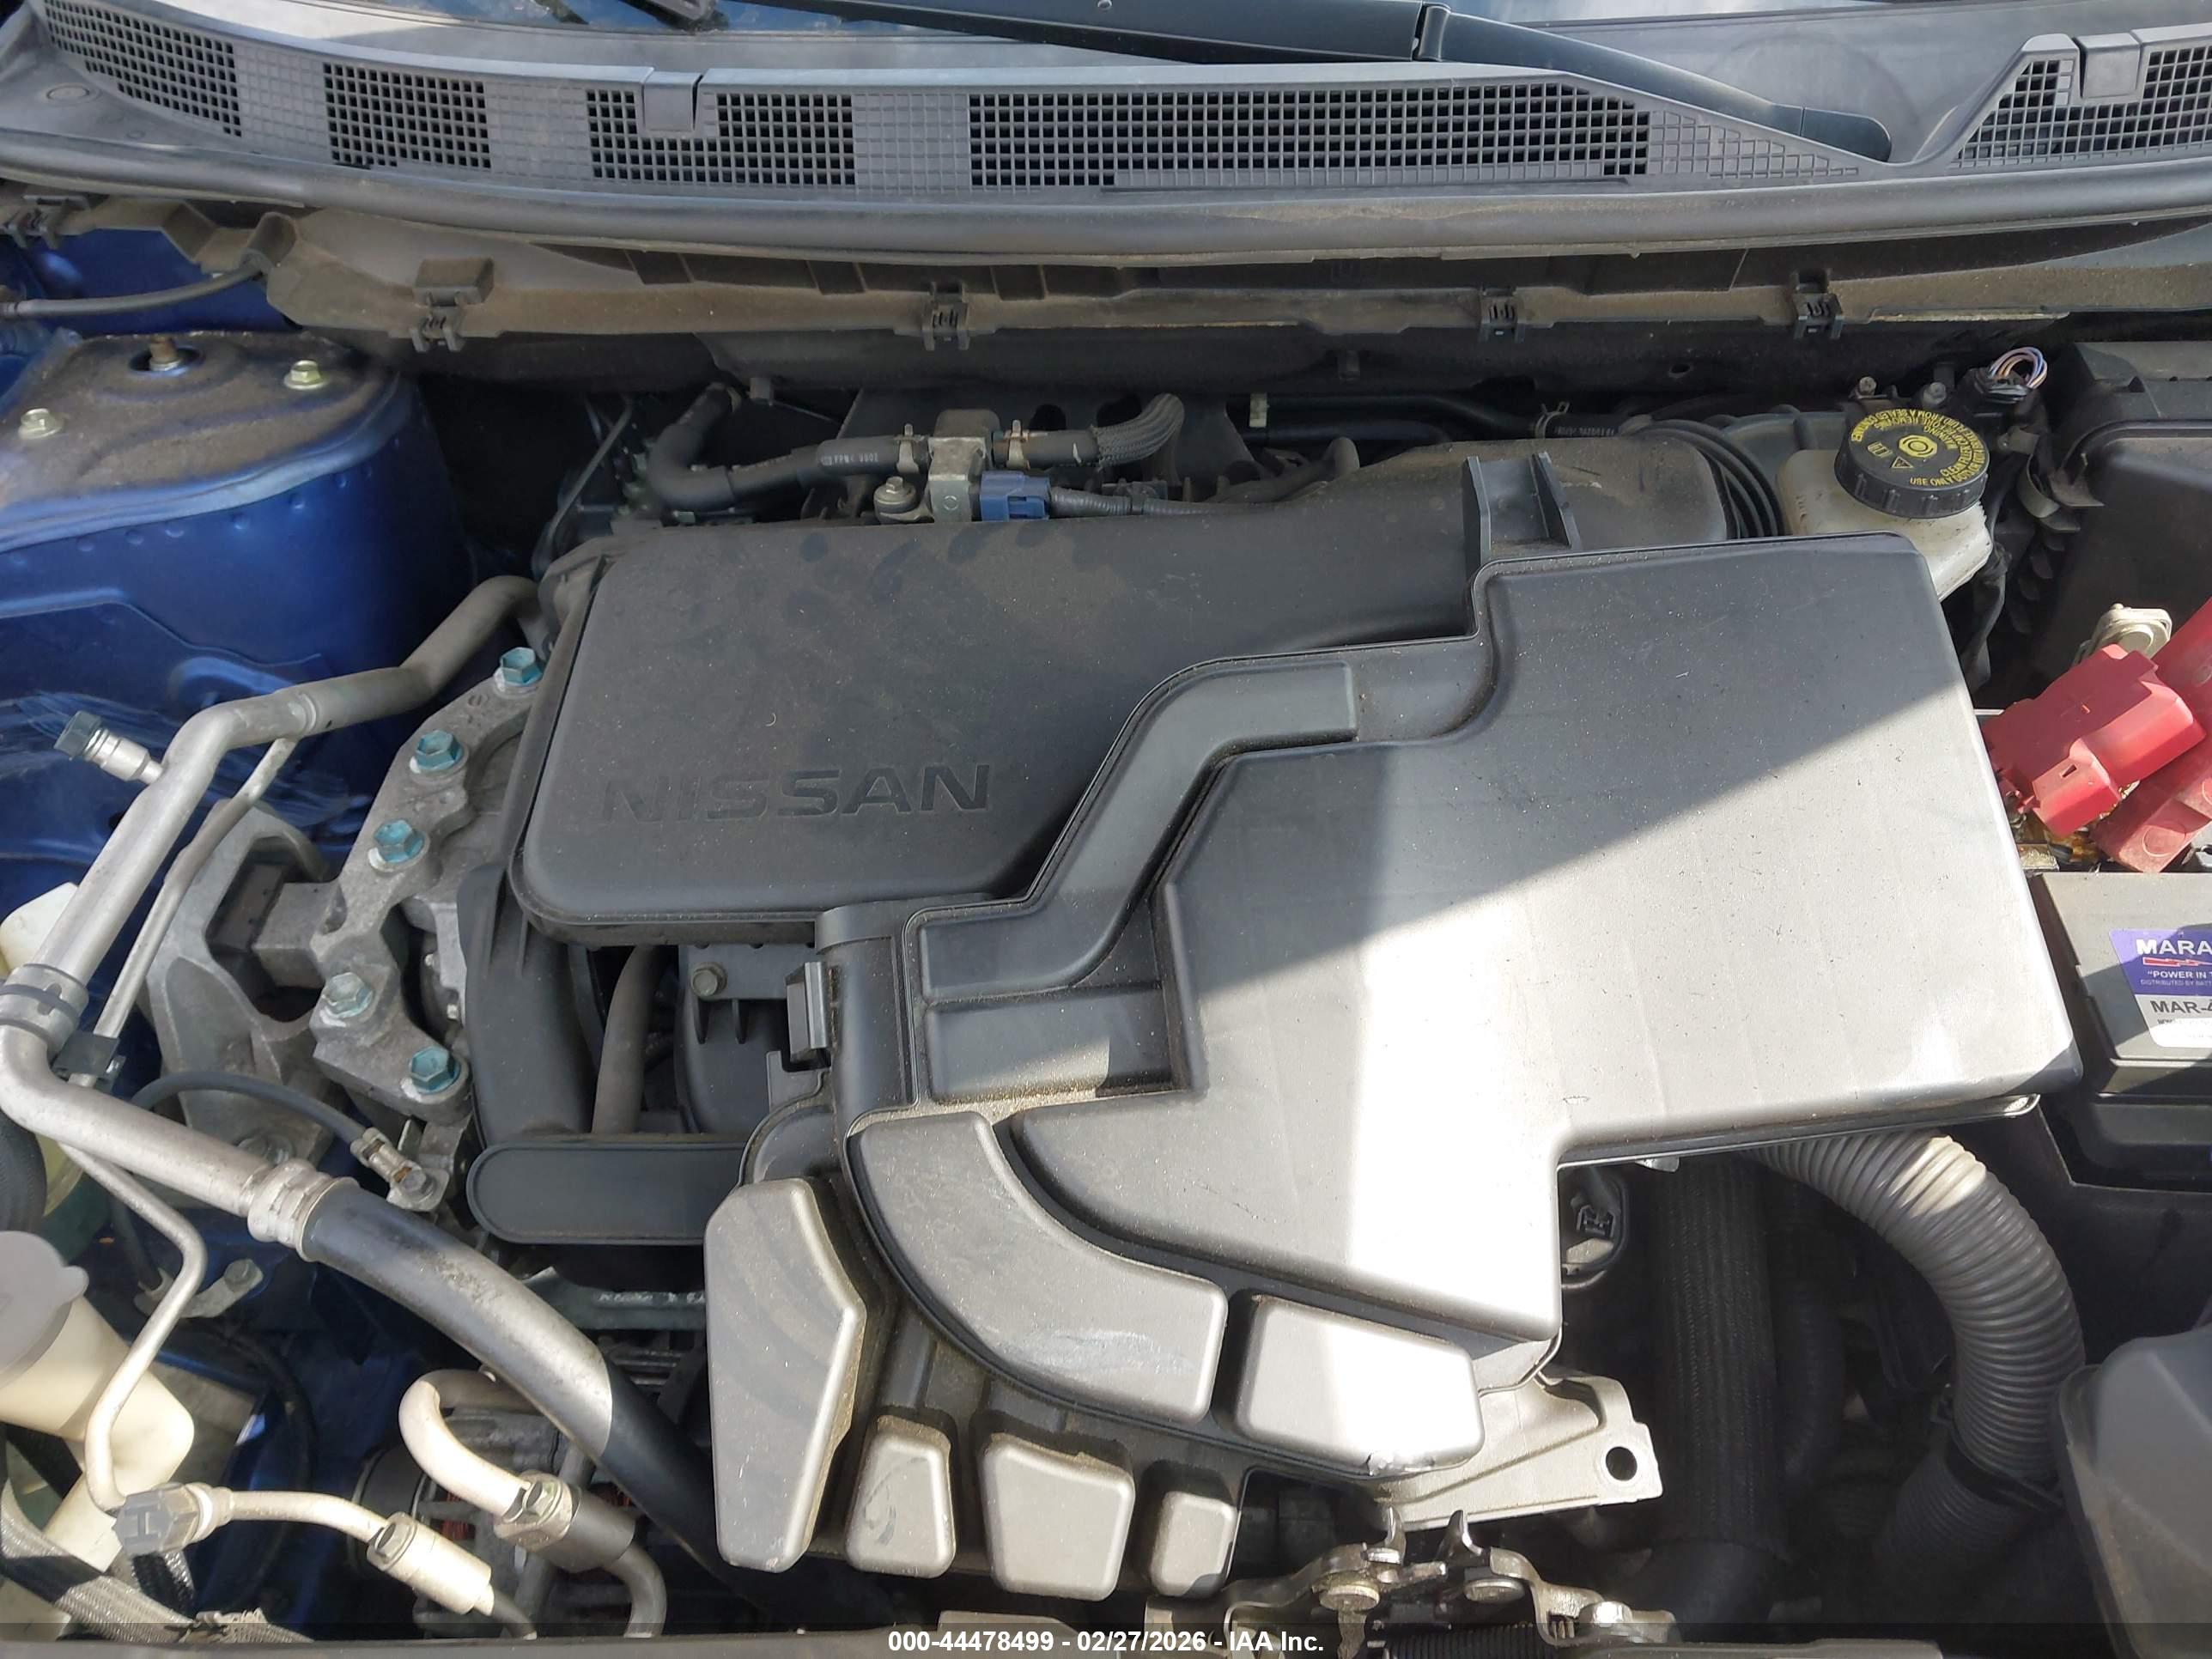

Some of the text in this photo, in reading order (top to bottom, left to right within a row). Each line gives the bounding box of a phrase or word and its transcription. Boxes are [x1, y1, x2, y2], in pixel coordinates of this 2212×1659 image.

[1909, 409, 1916, 417] A
[1917, 410, 1943, 422] FROM
[1930, 476, 1954, 486] ONLY
[603, 764, 990, 824] NISSAN
